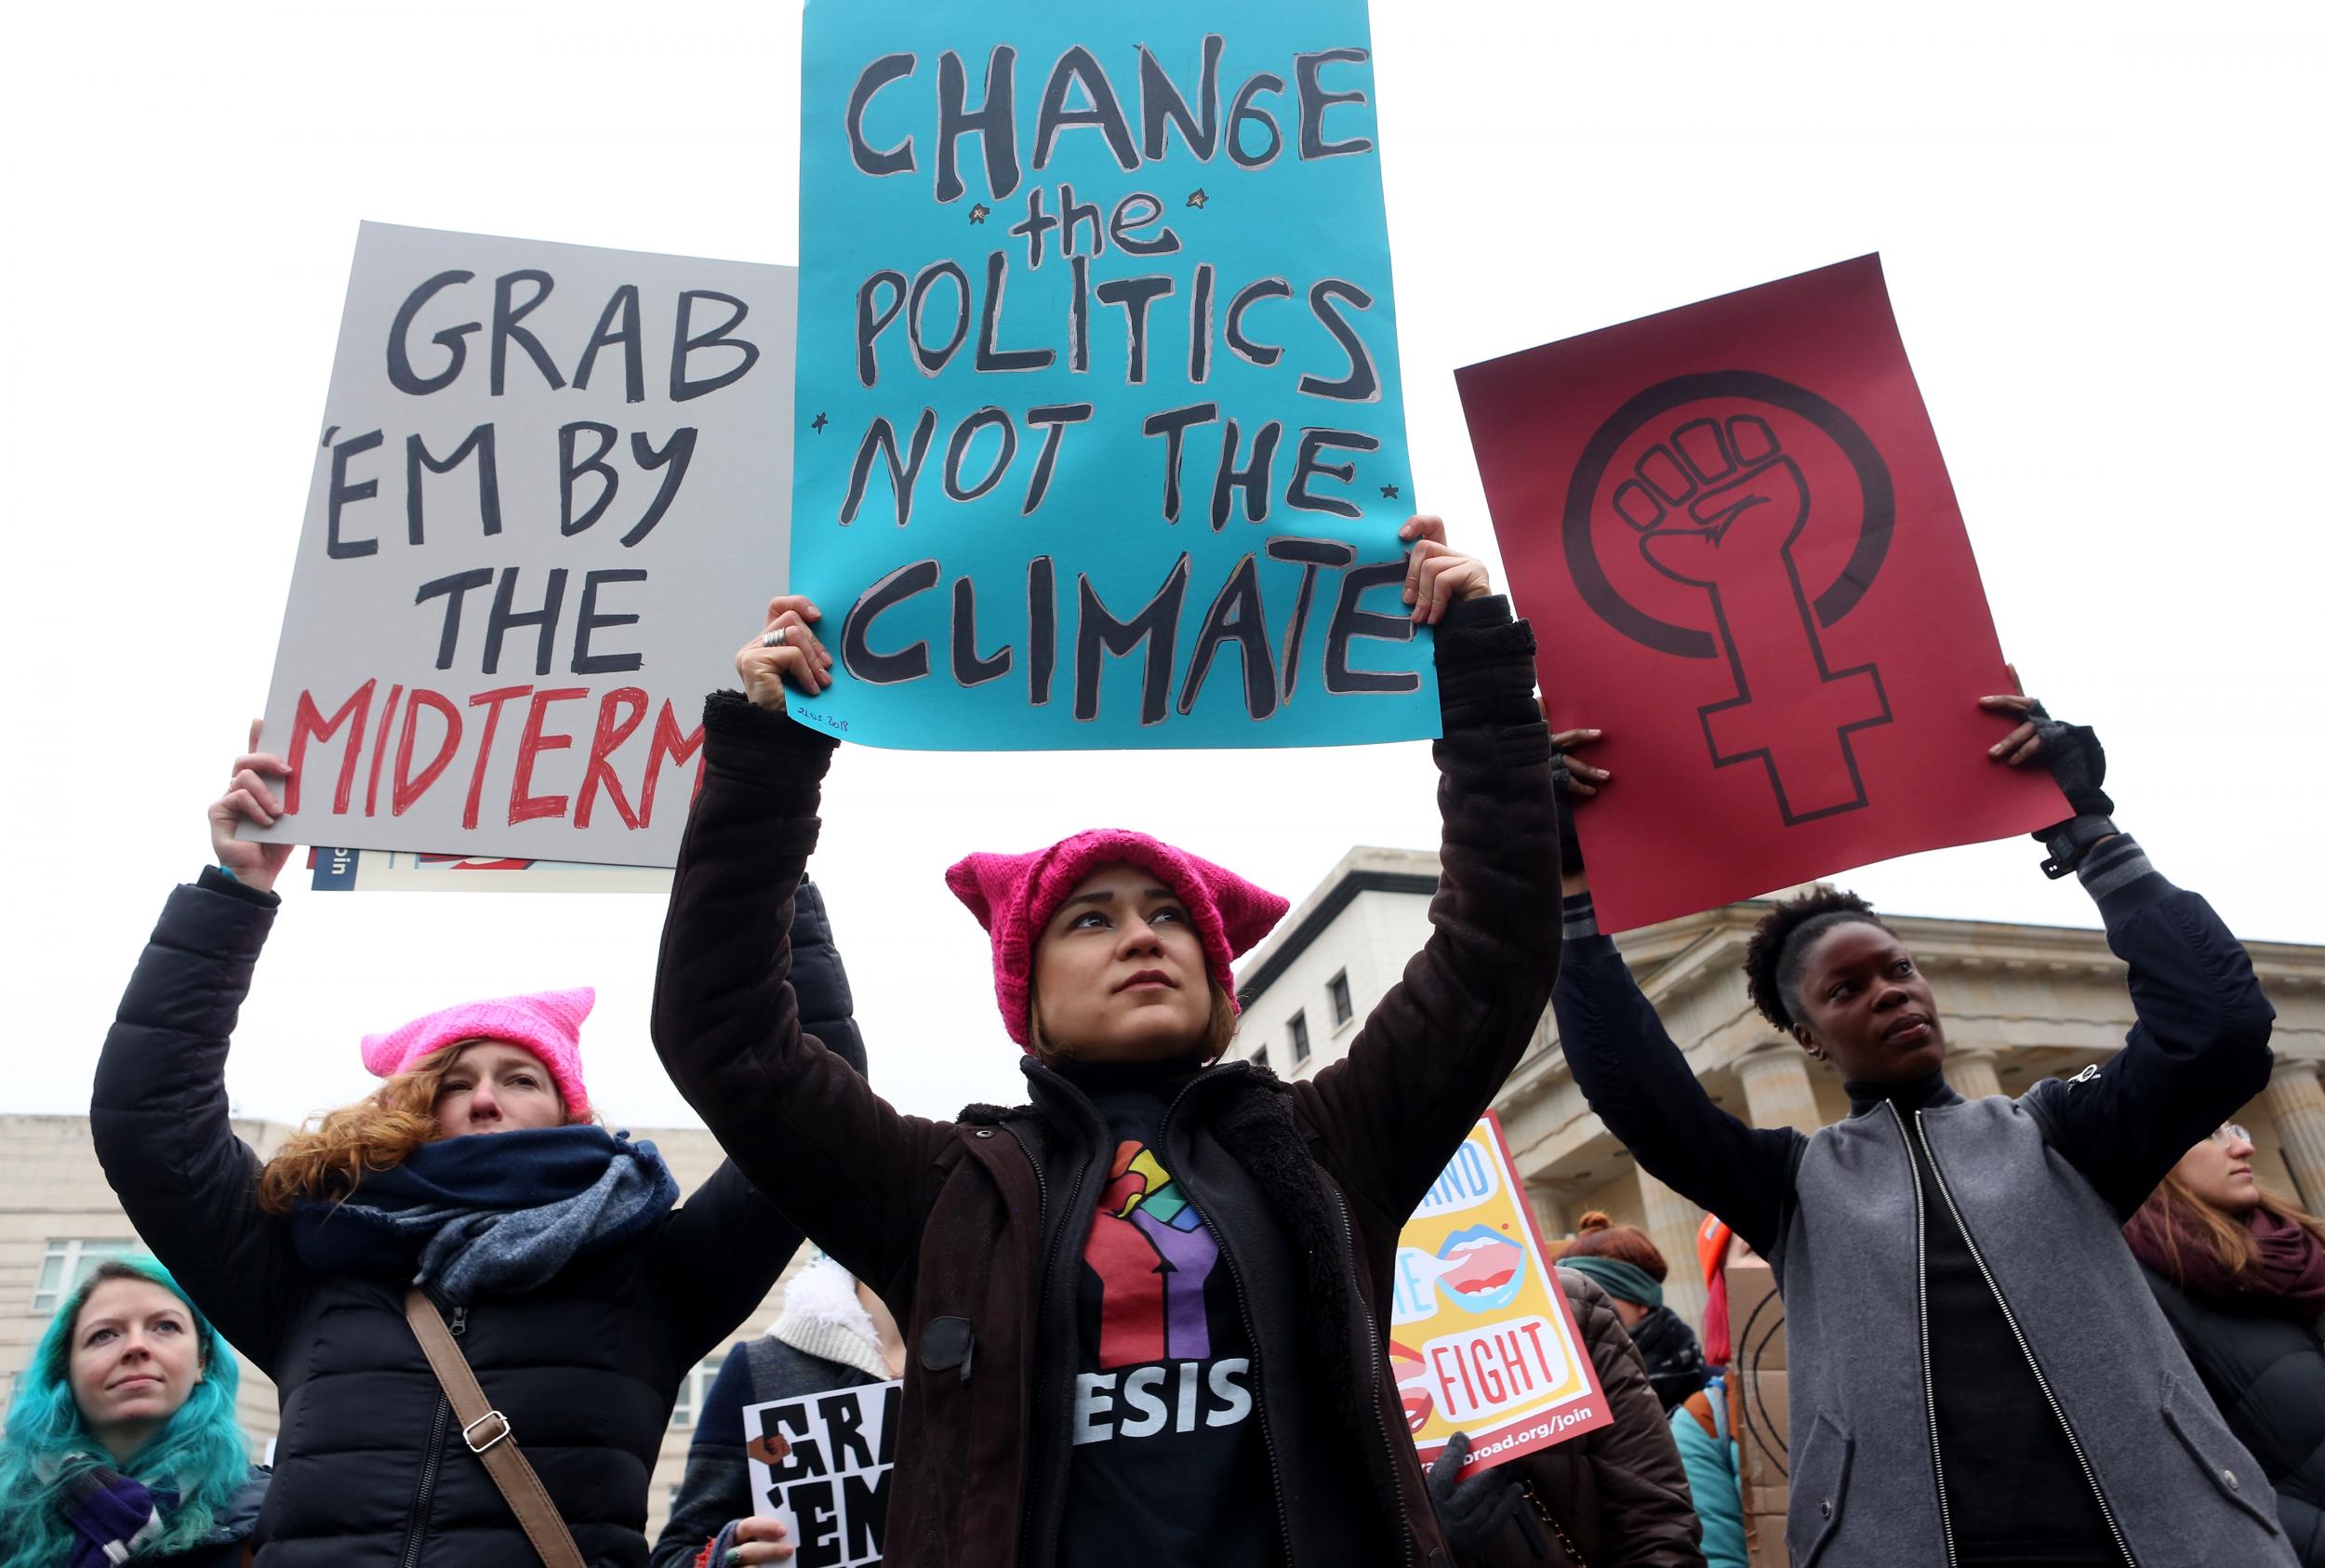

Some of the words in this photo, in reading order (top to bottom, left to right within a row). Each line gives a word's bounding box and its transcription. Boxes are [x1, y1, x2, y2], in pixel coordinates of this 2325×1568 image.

[844, 33, 1373, 203] CHANGE
[1008, 184, 1182, 269] the
[386, 269, 760, 404] GRAB
[855, 250, 1381, 404] POLITICS
[323, 422, 502, 559] 'EM
[559, 420, 698, 548] BY
[838, 402, 1094, 527] NOT
[1143, 402, 1379, 533] THE
[415, 566, 647, 675] THE
[841, 535, 1421, 727] CLIMATE
[1072, 1358, 1252, 1445] ESIS
[1431, 1322, 1553, 1415] FIGHT
